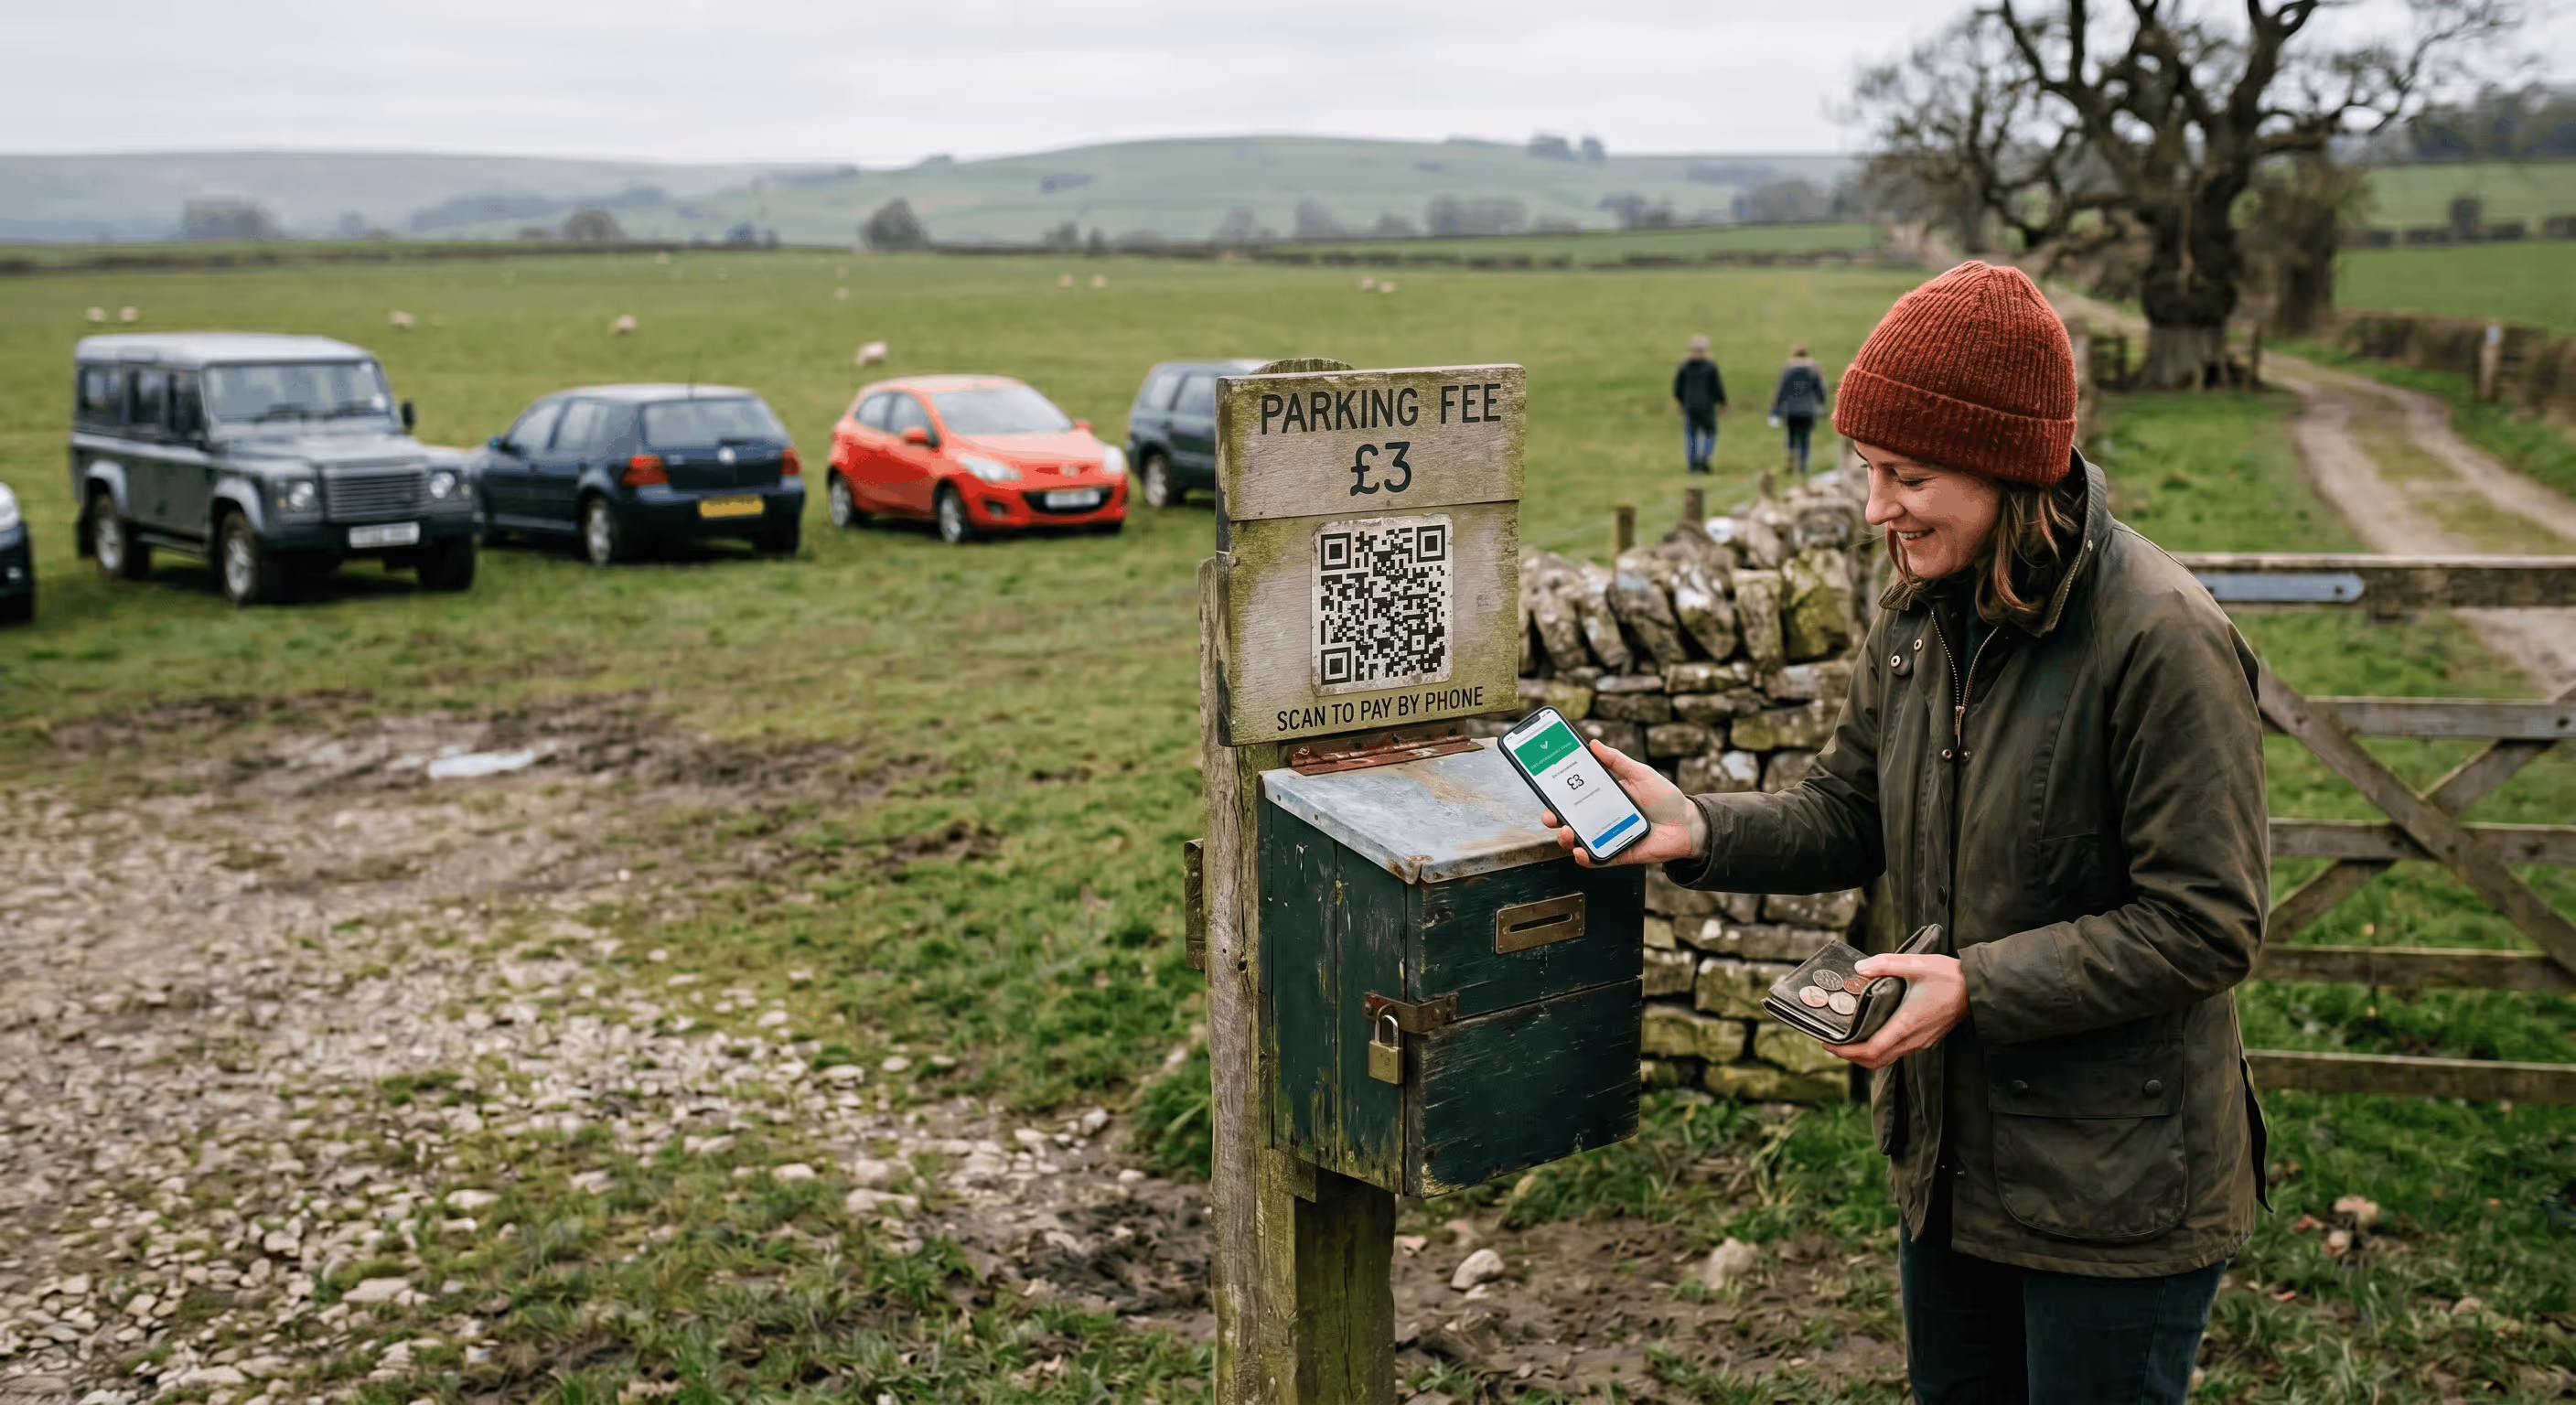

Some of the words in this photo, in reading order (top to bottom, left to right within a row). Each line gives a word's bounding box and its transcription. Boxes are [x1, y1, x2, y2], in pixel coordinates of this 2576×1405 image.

[1261, 387, 1419, 435] PARKING
[1440, 382, 1502, 424] FEE
[1349, 440, 1412, 497] £3
[1277, 706, 1326, 731] SCAN
[1331, 702, 1355, 724] TO
[1360, 697, 1392, 721] PAY
[1398, 693, 1420, 716] BY
[1425, 686, 1484, 712] PHONE
